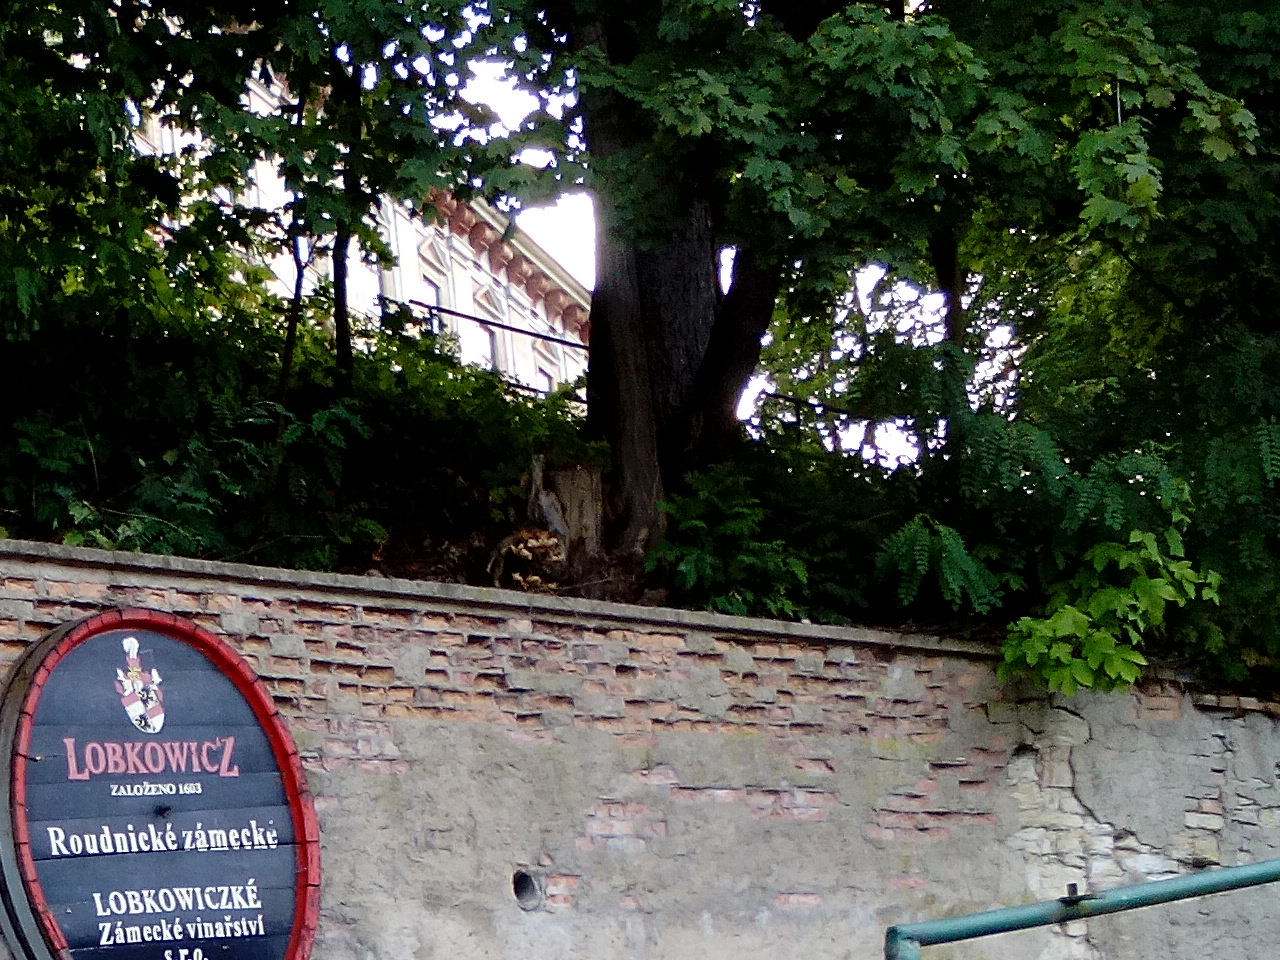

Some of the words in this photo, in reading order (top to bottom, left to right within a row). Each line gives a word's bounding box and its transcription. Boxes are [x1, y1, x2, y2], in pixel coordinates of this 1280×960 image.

[63, 736, 239, 780] LOBKOWICZ
[47, 822, 177, 856] Roudnické
[93, 878, 262, 917] LOBKOWICZKÉ
[99, 917, 184, 946] Zámecké
[186, 914, 265, 938] vinařství
